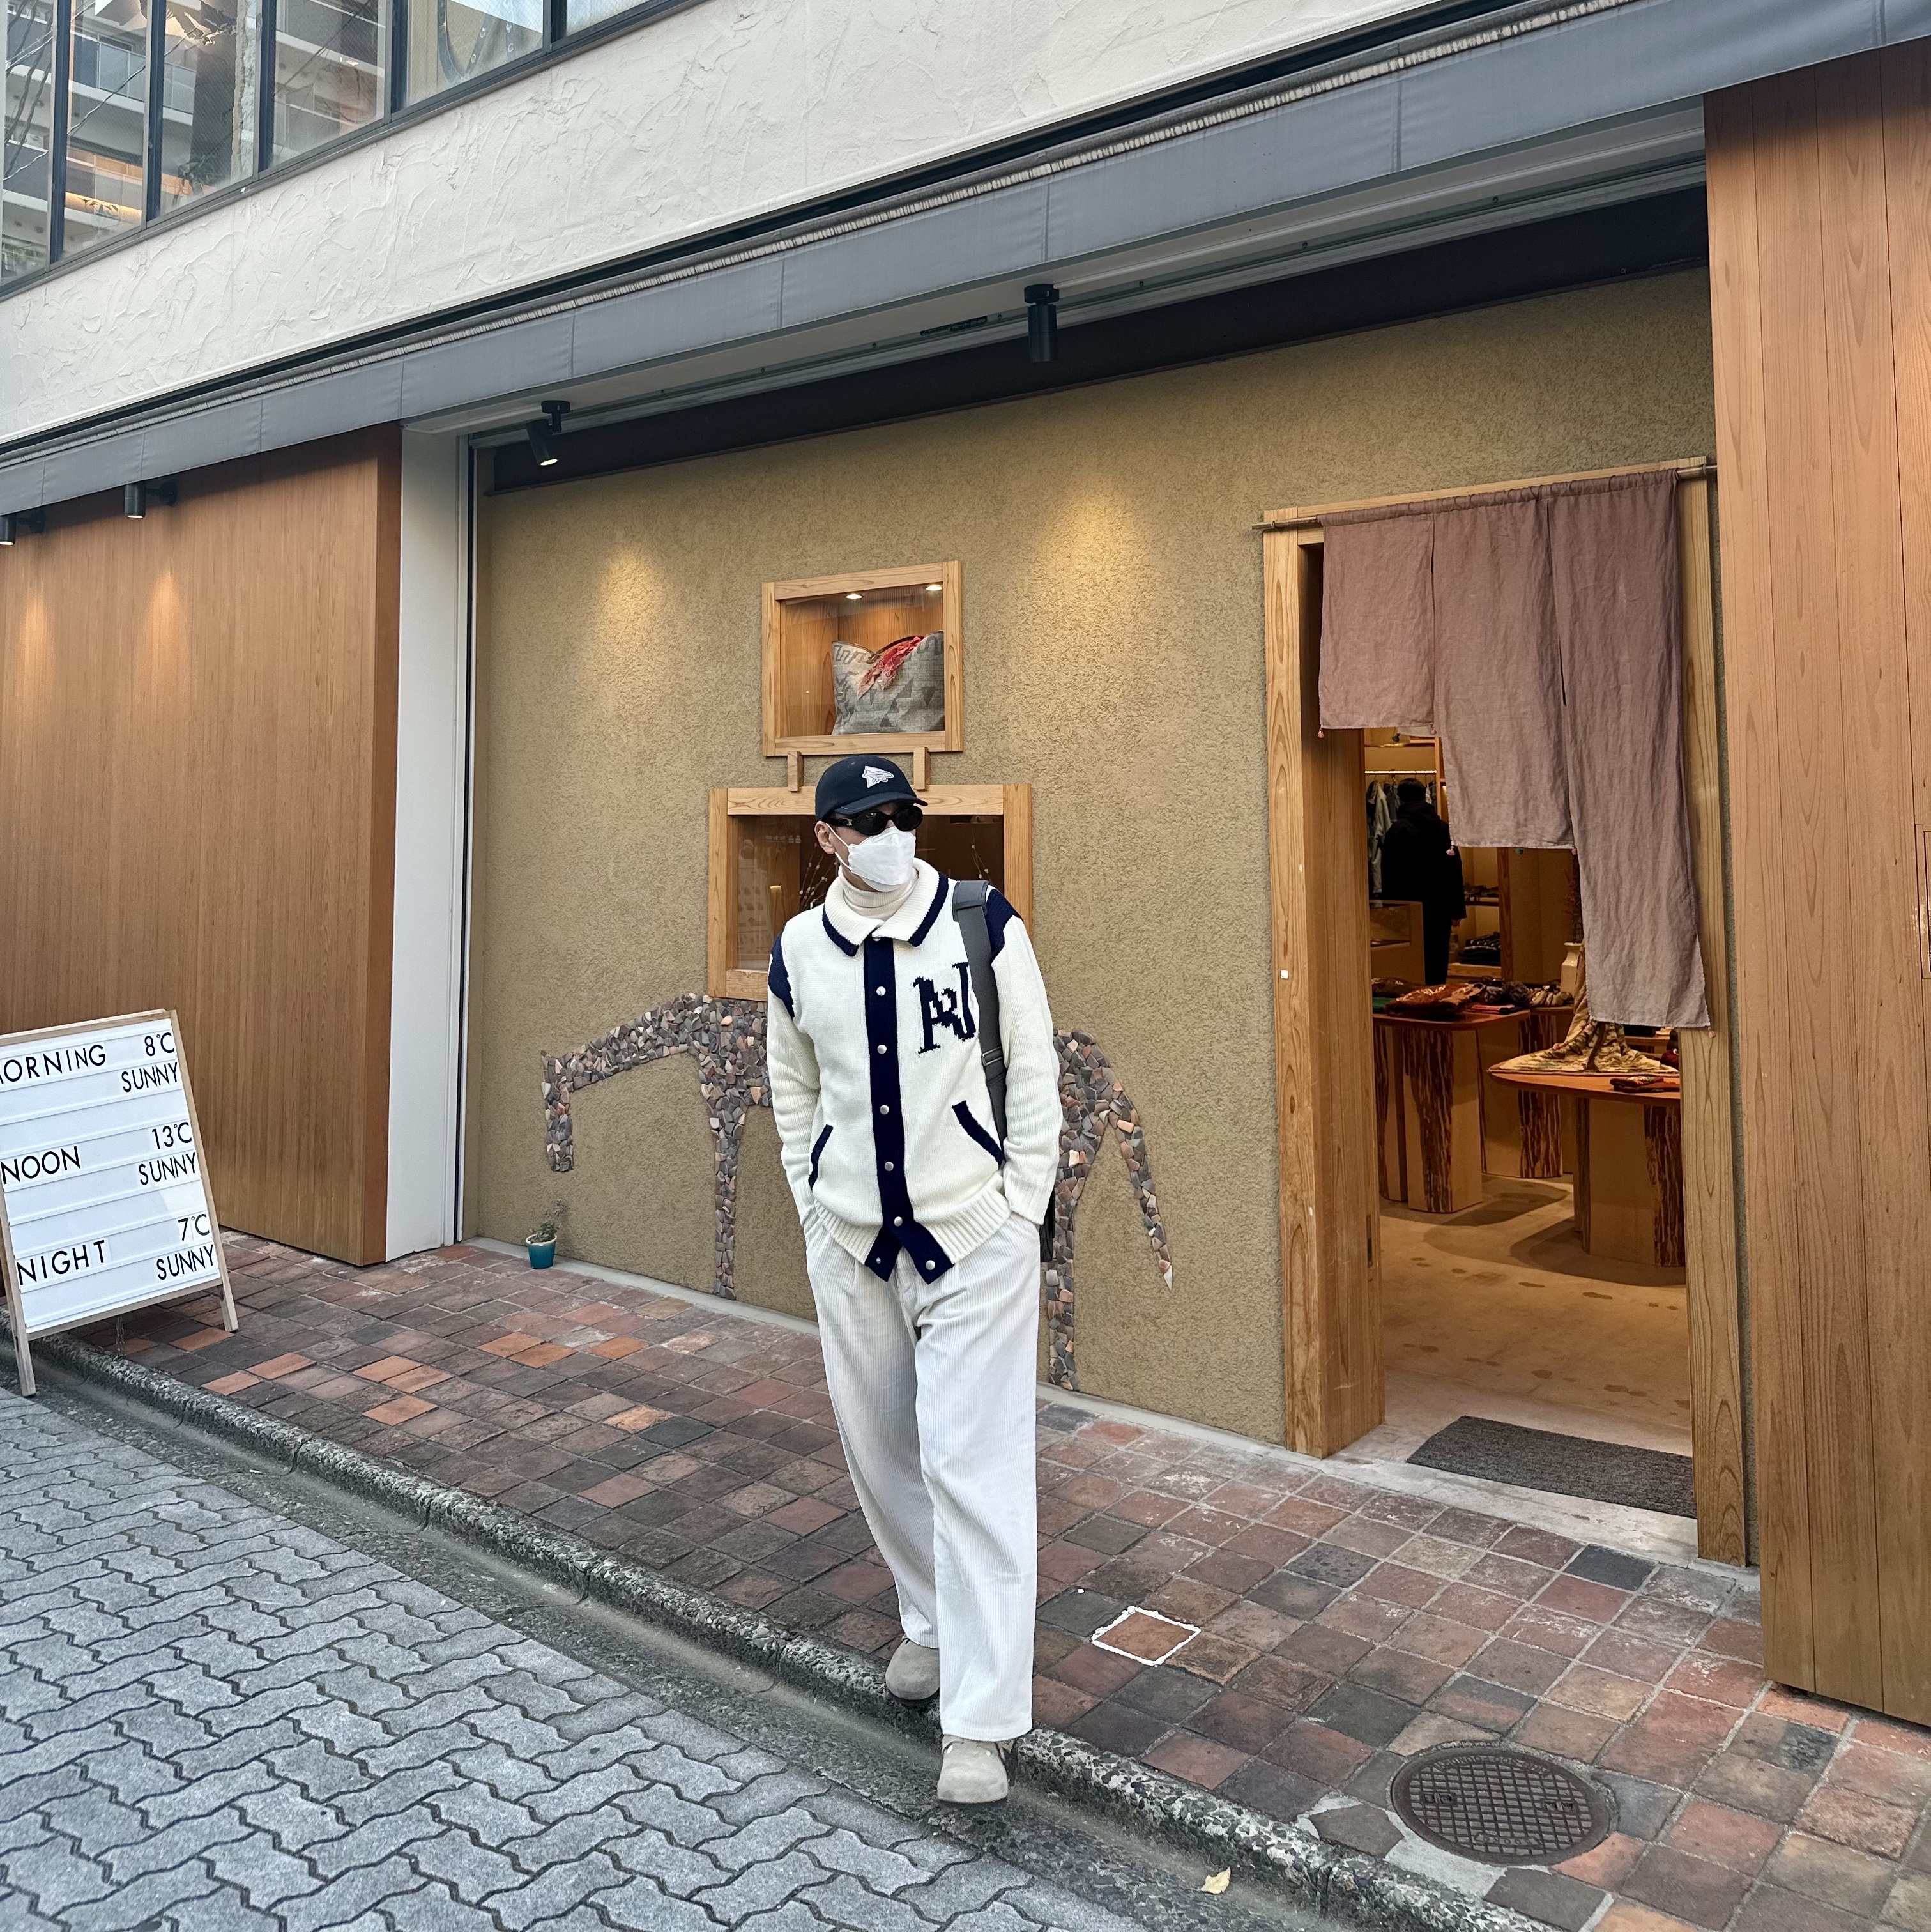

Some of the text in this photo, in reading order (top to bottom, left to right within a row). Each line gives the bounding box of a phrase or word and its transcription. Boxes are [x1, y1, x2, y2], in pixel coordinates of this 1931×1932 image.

[121, 1061, 178, 1092] SUNNY
[0, 1146, 80, 1184] NOON
[138, 1151, 195, 1186] SUNNY
[16, 1239, 105, 1285] NIGHT
[156, 1244, 213, 1280] SUNNY
